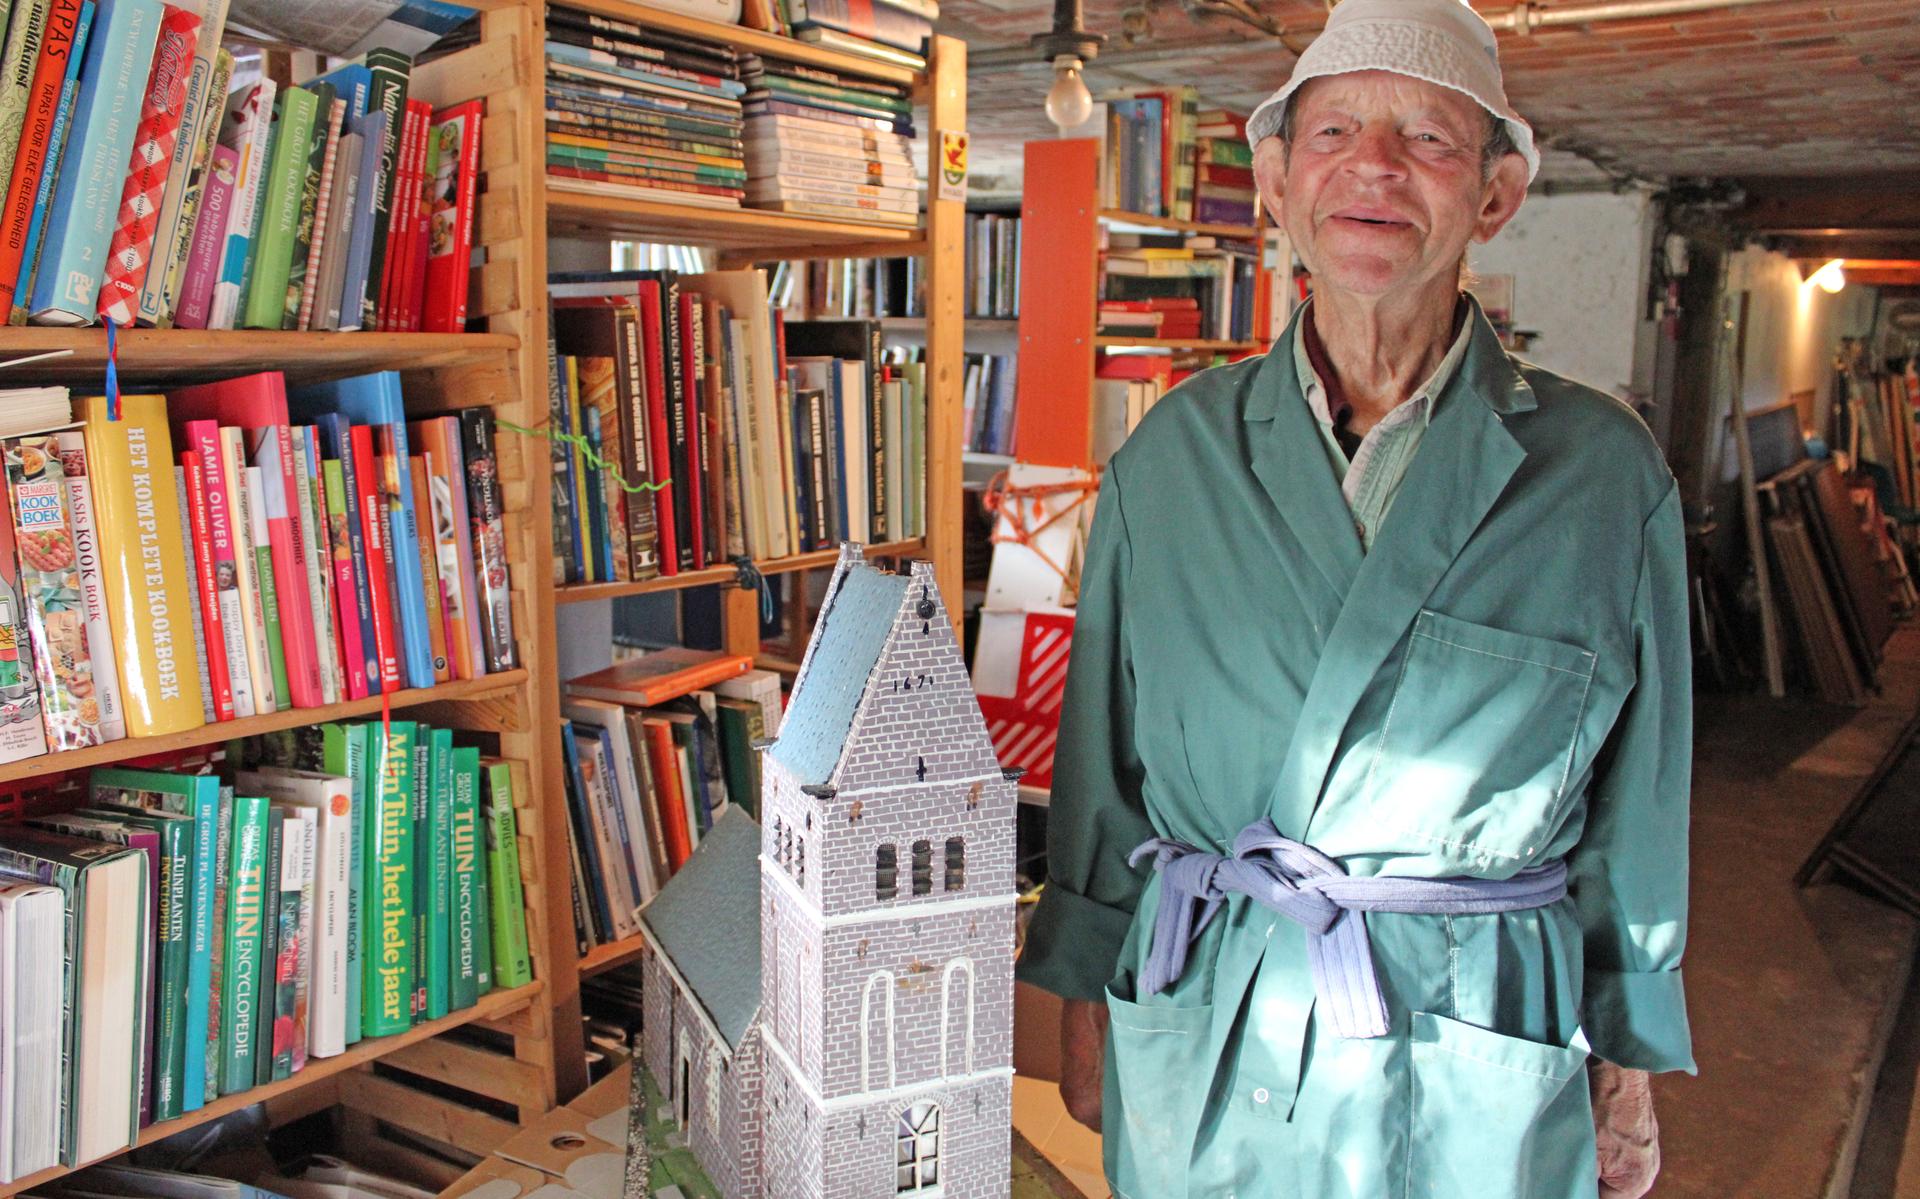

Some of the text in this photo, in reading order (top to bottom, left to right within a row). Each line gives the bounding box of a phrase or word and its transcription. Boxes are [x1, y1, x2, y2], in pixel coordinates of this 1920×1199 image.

[16, 2, 43, 88] naaldkunst
[58, 79, 74, 111] SPEELSE
[174, 63, 204, 163] Creatief met Kinderen
[49, 111, 66, 150] MOTIEFJES
[8, 81, 55, 249] TAPAS VOOR ELKE GELEGENHEID
[35, 159, 55, 206] KRUISSTEEK
[279, 99, 309, 233] HET GROTE KOOKBOEK
[207, 184, 225, 210] 500
[240, 186, 255, 228] AFVALLEN
[80, 246, 92, 260] 2
[194, 208, 215, 255] gerechten
[668, 282, 684, 445] VROUWEN IN DE BIJBEL
[692, 302, 704, 379] REVOLUTIE
[872, 330, 881, 370] Nieuwe
[545, 338, 560, 409] FRIESLAND
[626, 321, 645, 472] EUROPA IN DE GOUDEN EEUW
[280, 440, 288, 452] pas
[283, 454, 293, 475] koken
[192, 465, 201, 488] Koken
[195, 489, 203, 504] met
[201, 435, 227, 549] JAMIE OLIVER
[21, 496, 58, 509] KOOK
[23, 510, 60, 523] BOEK
[197, 505, 207, 533] Kanjers
[240, 490, 249, 520] recepten
[405, 509, 415, 538] GRIEKS
[71, 483, 101, 622] BASIS KOOK BOEK
[243, 522, 253, 547] volgens
[247, 549, 254, 557] de
[289, 515, 303, 564] SMOOTHIES
[379, 503, 393, 563] Barbecuen
[127, 427, 178, 700] HET KOMPLETE KOOKBOEK
[248, 559, 258, 589] methode
[260, 551, 278, 621] VETARM ETEN
[341, 566, 350, 580] Vis
[416, 535, 436, 608] spaanse
[207, 591, 218, 621] Heijden
[251, 591, 263, 626] Montignac
[357, 587, 369, 620] recepten
[221, 602, 238, 679] the Naked Chef
[230, 599, 248, 679] Happy Days met
[893, 674, 934, 692] 1671
[410, 745, 420, 820] Borders en perken
[456, 772, 464, 803] GROTE
[462, 772, 471, 803] DELTAS
[215, 806, 229, 884] Wim Oudshoorn
[250, 825, 261, 860] DELTAS
[301, 821, 313, 879] SNOEIEN
[347, 742, 362, 961] Thieme VASTE PLANTEN ALAN BLOOM
[159, 856, 170, 941] ENCYCLOPEDIE
[170, 855, 186, 941] TUINPLANTEN
[194, 804, 211, 951] DE GROTE PLANTENKIEZER
[377, 733, 407, 1019] Mijn Tuin, het hele jaar
[455, 807, 474, 978] TUIN ENCYCLOPEDIE
[299, 881, 310, 920] WAAR
[281, 901, 296, 984] TUINDROMEN
[299, 921, 308, 933] &
[234, 864, 261, 1057] TUIN ENCYCLOPEDIE
